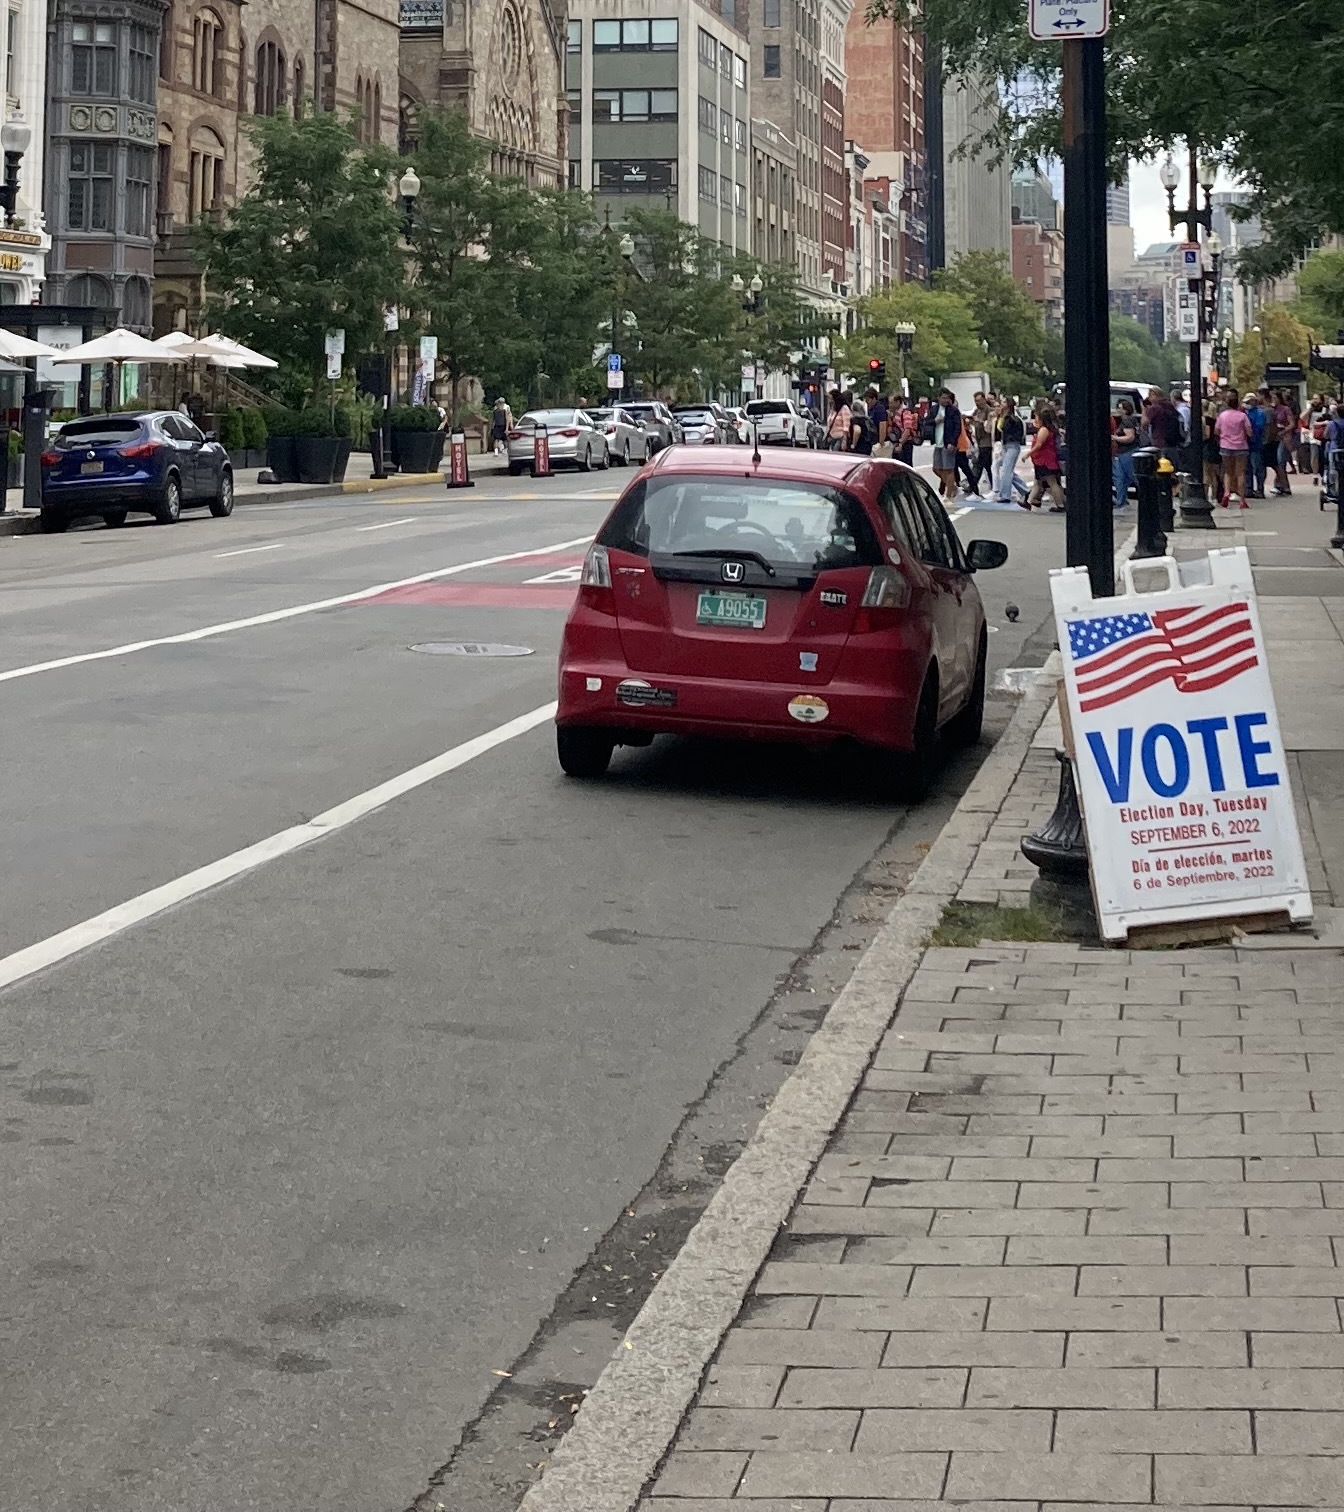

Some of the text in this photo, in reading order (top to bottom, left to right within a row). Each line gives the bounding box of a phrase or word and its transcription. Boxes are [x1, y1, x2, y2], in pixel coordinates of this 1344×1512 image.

[1059, 8, 1078, 17] Only
[455, 444, 463, 482] HOTEL
[717, 599, 758, 619] A9055
[1085, 712, 1280, 804] VOTE
[1120, 795, 1267, 823] Election Day, Tuesday
[1130, 819, 1261, 845] SEPTEMBER 6, 2022
[1156, 857, 1169, 871] de
[1231, 849, 1273, 862] martes
[1133, 865, 1274, 890] 6 de Septiembre, 2022
